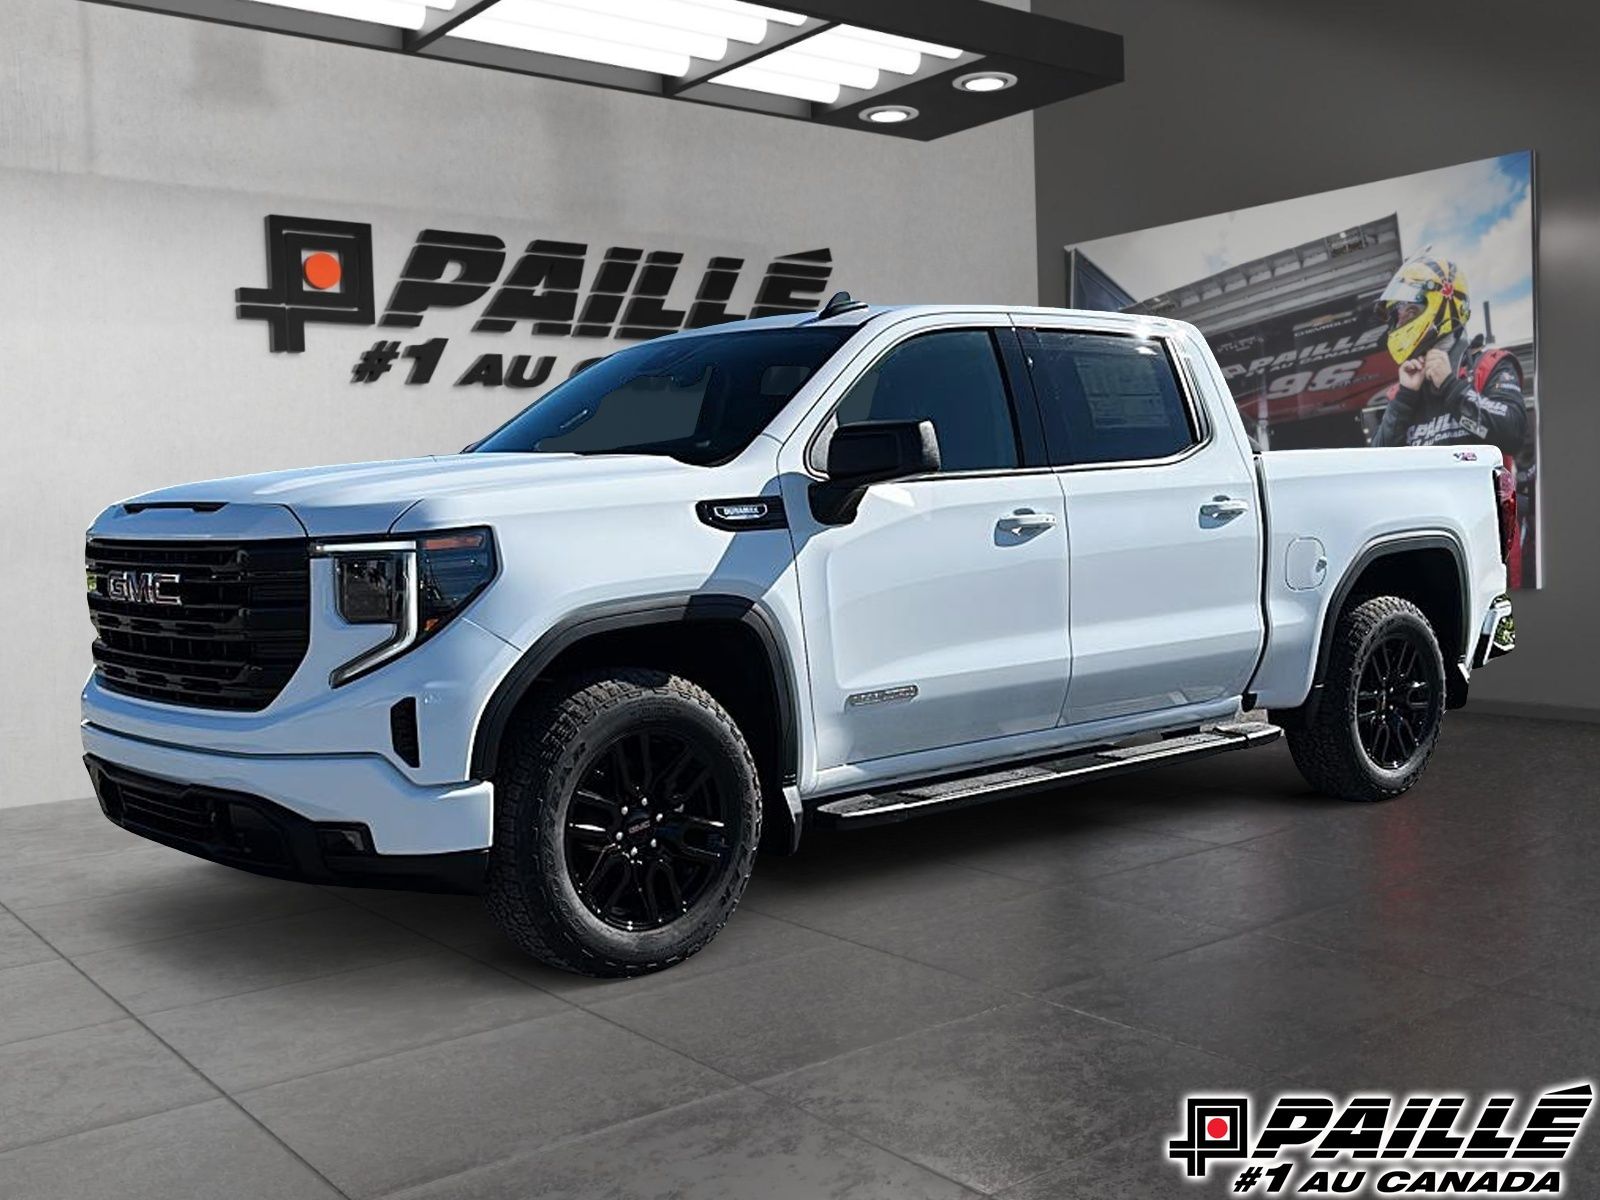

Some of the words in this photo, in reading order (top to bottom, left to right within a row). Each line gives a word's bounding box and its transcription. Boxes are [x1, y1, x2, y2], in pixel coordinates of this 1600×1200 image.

[377, 229, 833, 339] PAILLÉ
[350, 337, 450, 386] #1
[453, 353, 558, 389] AU
[1300, 342, 1379, 365] CANADA
[1266, 360, 1364, 399] 96
[108, 570, 182, 606] GMC
